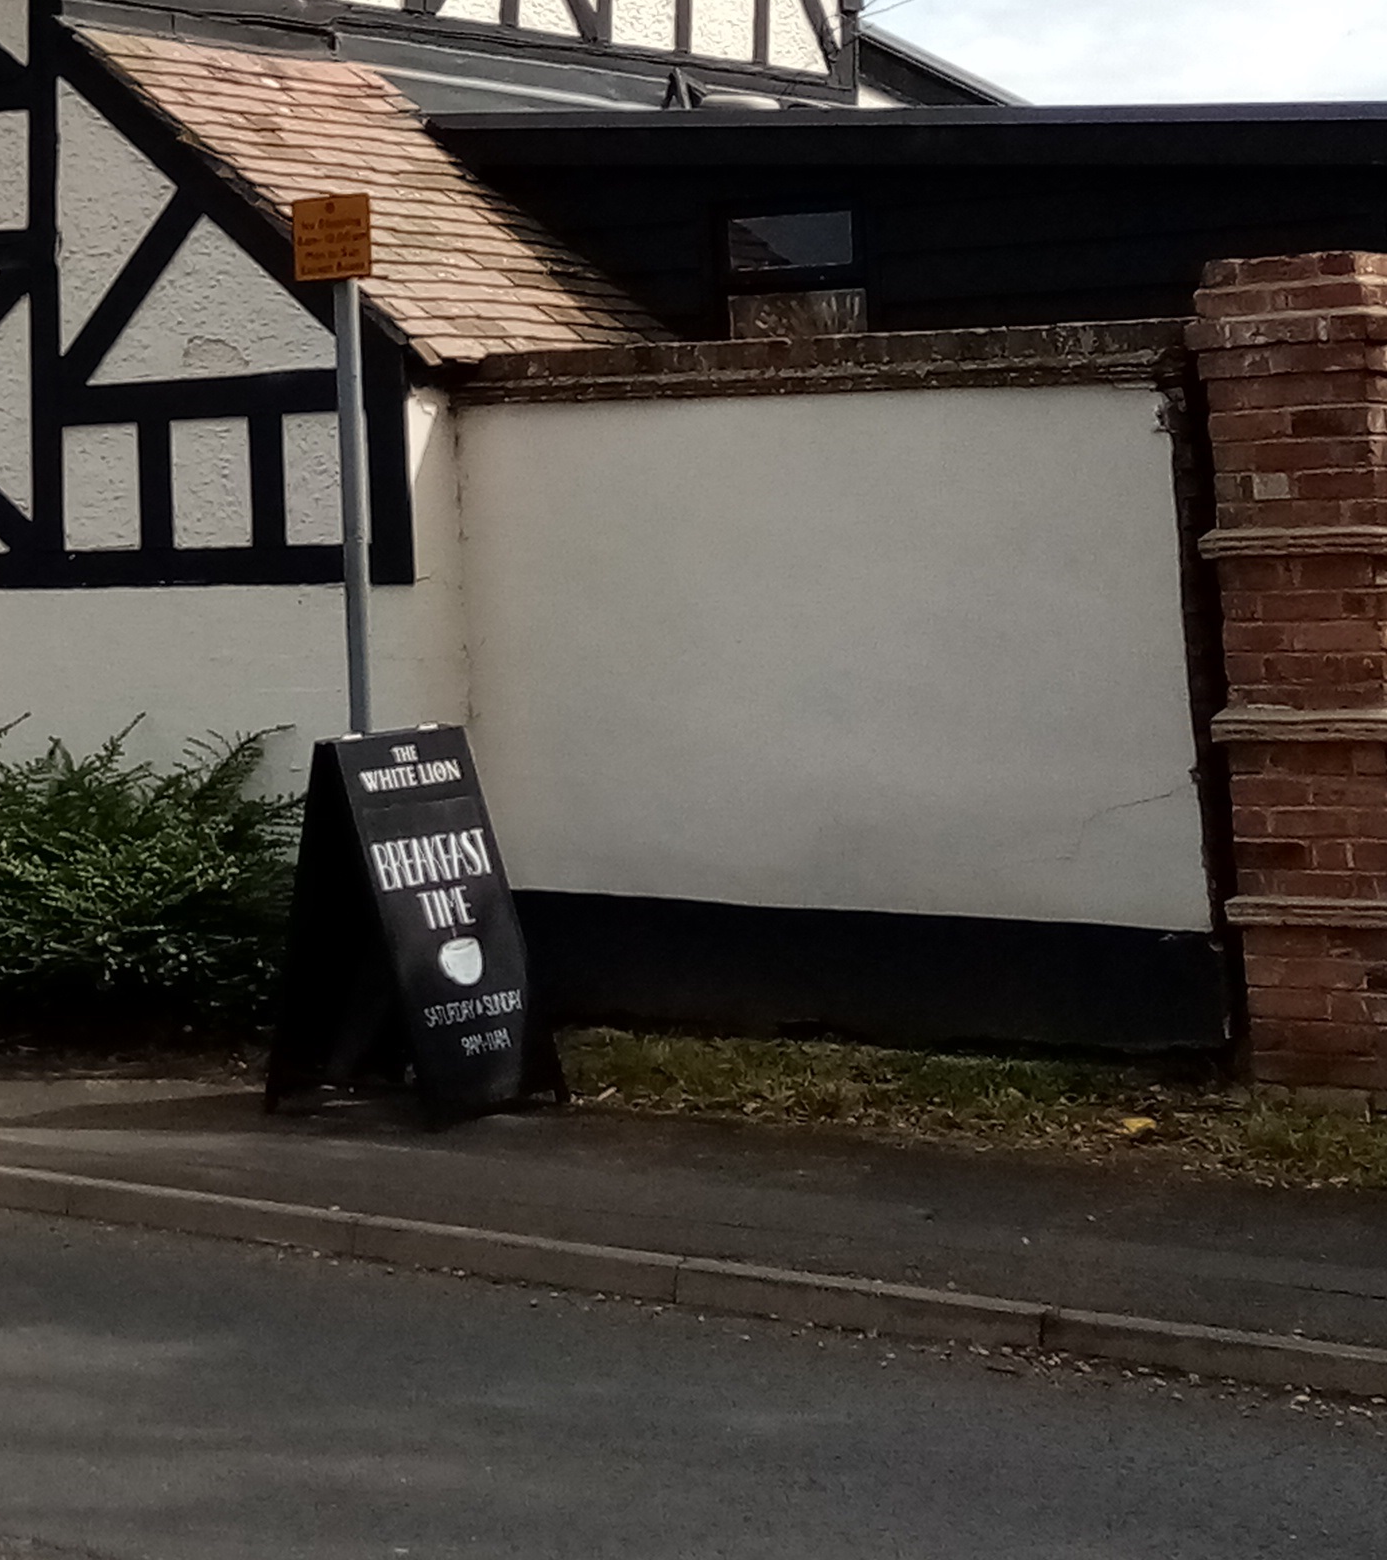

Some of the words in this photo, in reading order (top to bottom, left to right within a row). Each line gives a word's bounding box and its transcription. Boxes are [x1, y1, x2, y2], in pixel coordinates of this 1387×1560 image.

[390, 744, 418, 762] THE
[359, 765, 418, 793] WHITE
[417, 758, 463, 785] LION
[370, 827, 493, 892] BREAKFAST
[416, 885, 477, 930] TIME
[423, 998, 476, 1028] SATURDAY
[482, 989, 524, 1017] SUNDAY
